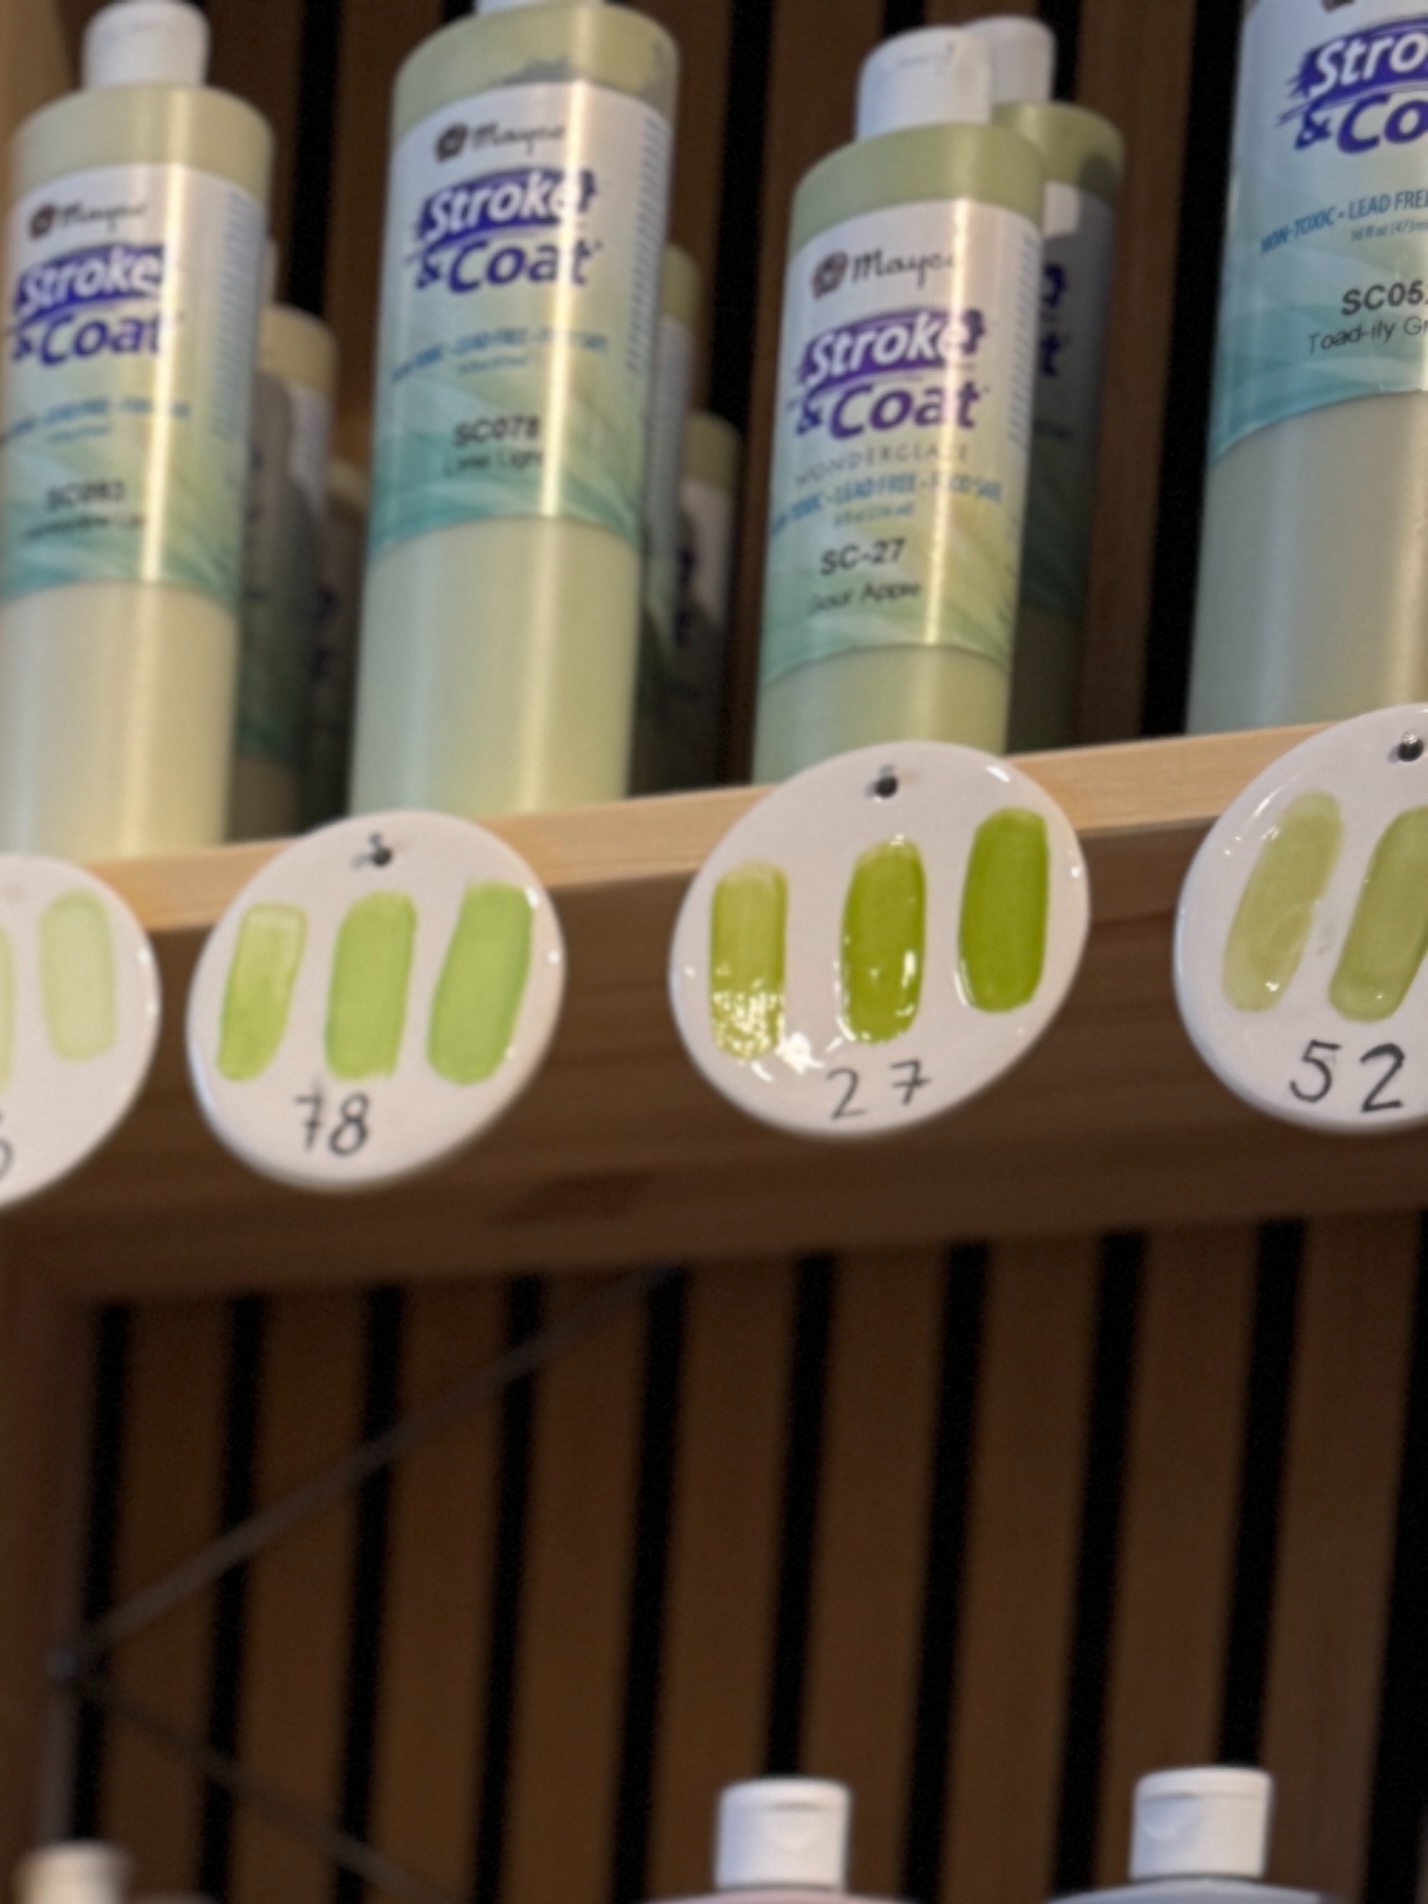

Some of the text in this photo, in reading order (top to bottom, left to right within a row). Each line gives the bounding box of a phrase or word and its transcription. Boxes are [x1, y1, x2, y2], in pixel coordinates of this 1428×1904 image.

[421, 169, 584, 242] Stroke
[1346, 193, 1392, 221] LEAD
[16, 246, 163, 318] Stroke
[447, 238, 593, 297] Coat
[1340, 278, 1428, 317] SC05
[40, 312, 161, 368] Coat
[805, 309, 972, 387] Stroke
[1307, 317, 1397, 356] Toad-ily
[828, 379, 981, 441] Coat
[796, 442, 969, 487] WONDERGLAE
[819, 534, 907, 578] SC-27
[824, 1058, 932, 1121] 27
[1289, 1038, 1407, 1114] 52
[294, 1088, 371, 1158] 78
